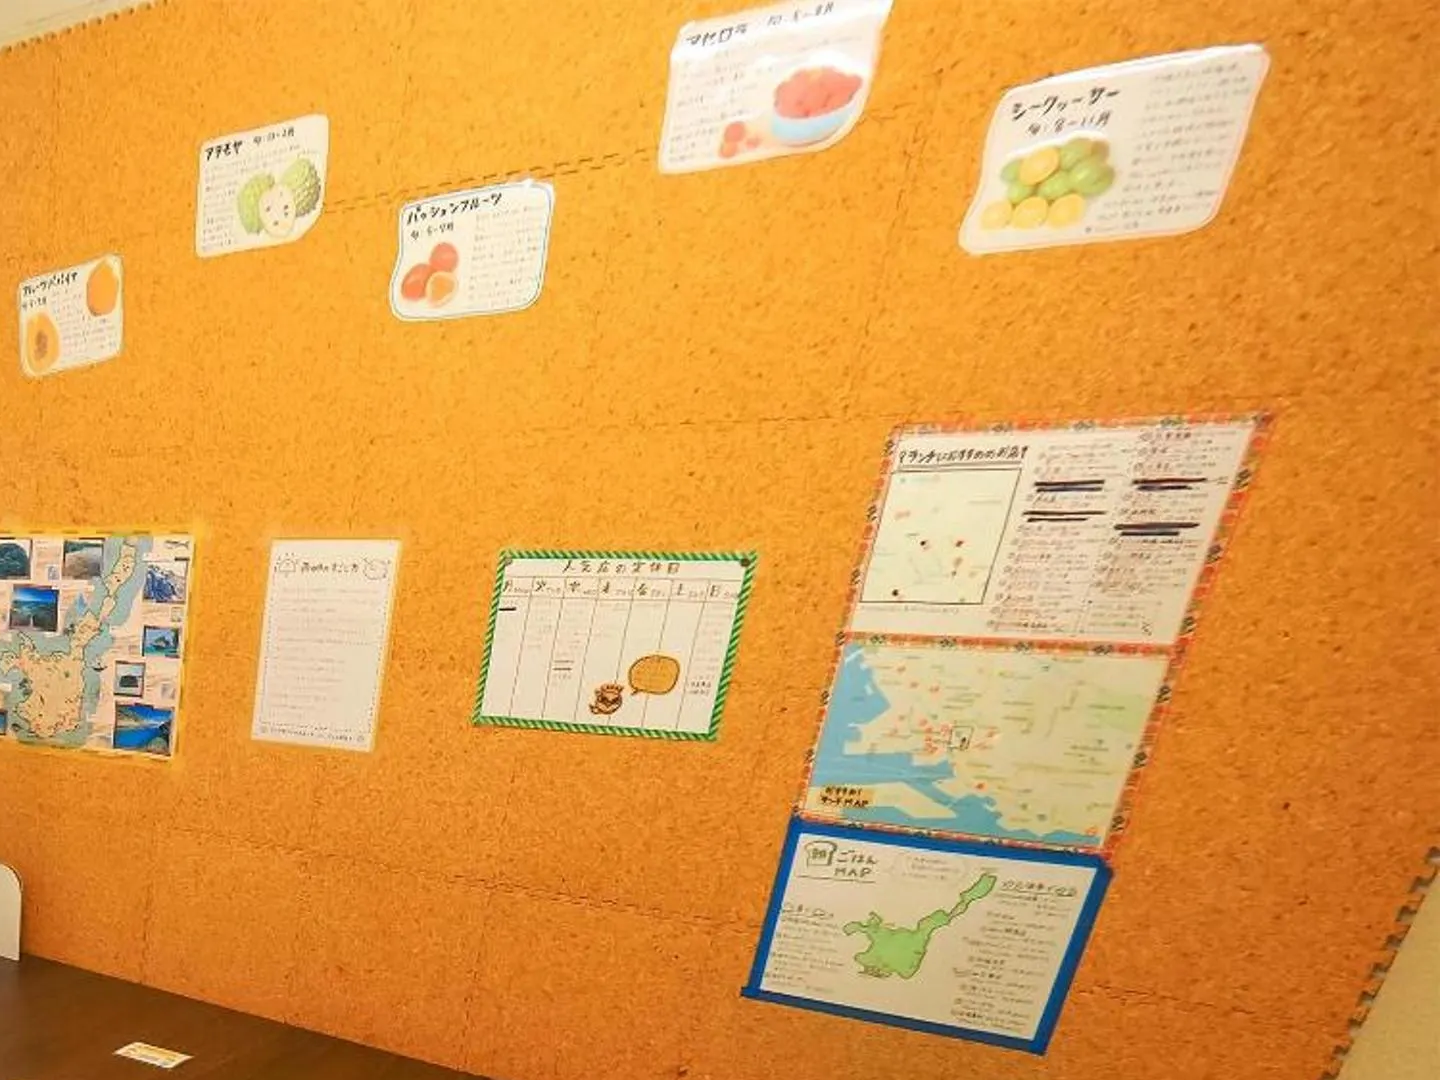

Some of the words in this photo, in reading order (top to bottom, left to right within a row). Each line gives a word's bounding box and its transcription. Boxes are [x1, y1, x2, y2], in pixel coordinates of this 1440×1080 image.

[406, 192, 502, 225] パッションフルーツ
[834, 867, 872, 878] MAP
